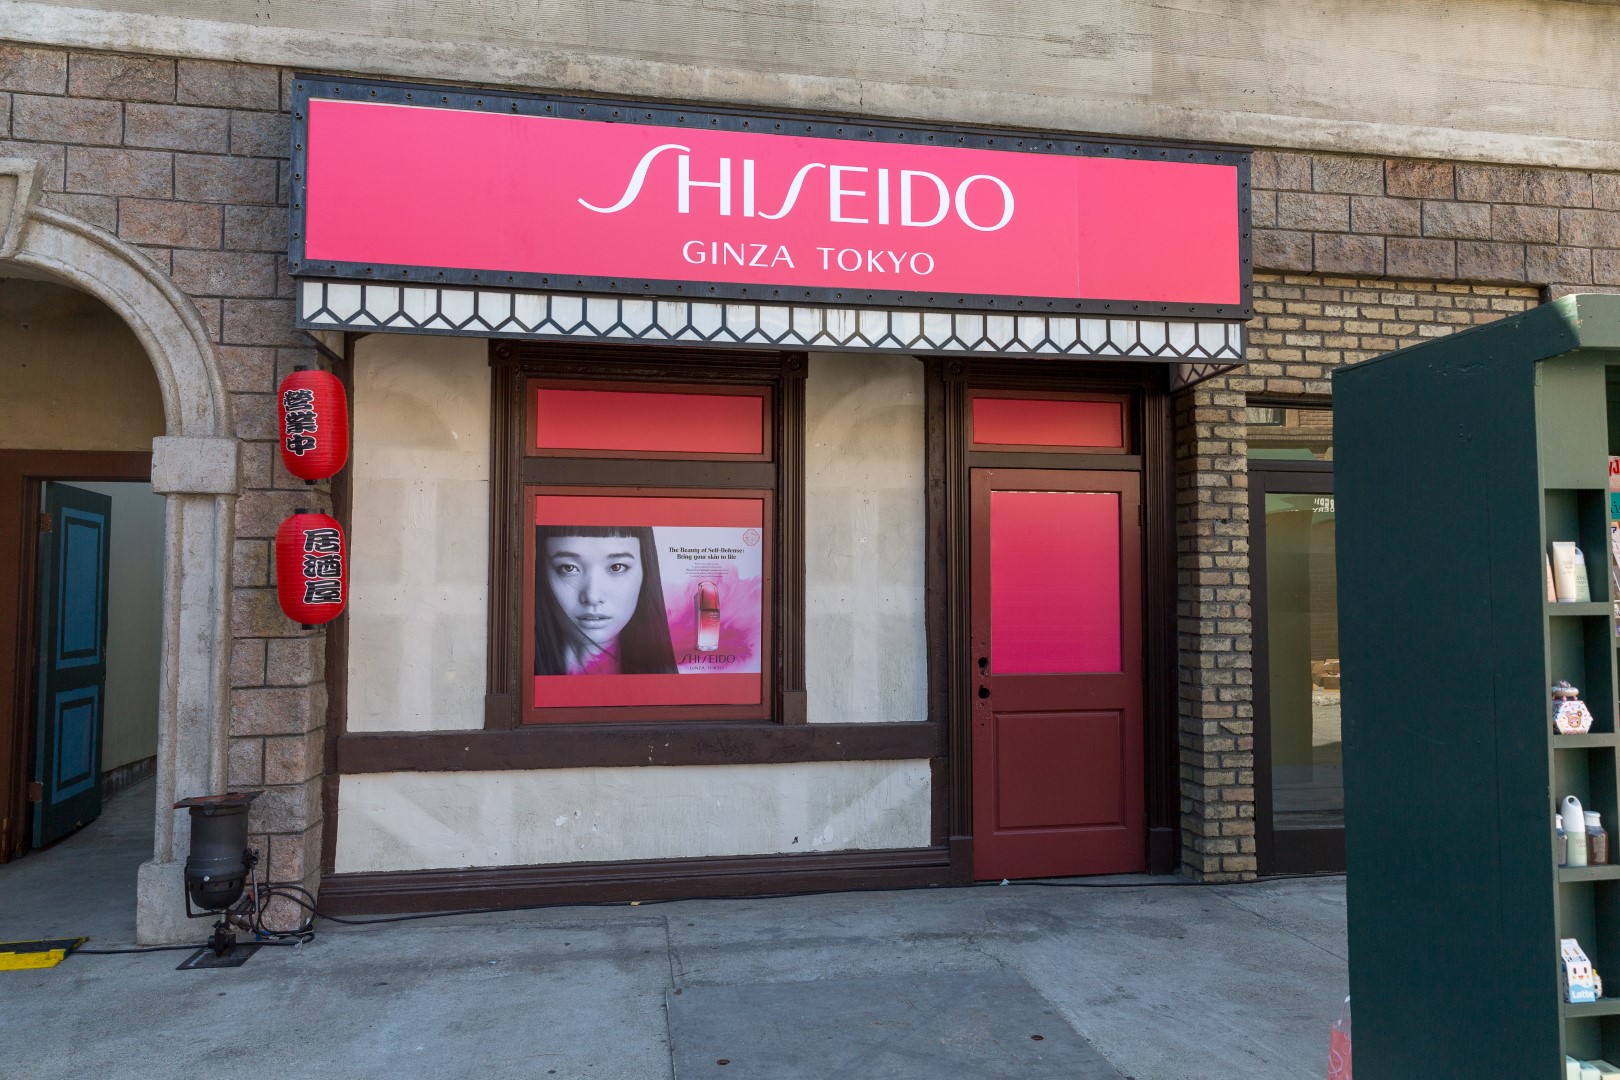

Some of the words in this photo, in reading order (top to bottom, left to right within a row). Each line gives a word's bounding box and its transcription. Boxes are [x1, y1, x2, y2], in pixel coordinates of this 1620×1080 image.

[577, 143, 1015, 232] SHISEIDO
[682, 240, 795, 269] GINZA
[816, 247, 935, 275] TOKYO
[680, 547, 700, 555] Beauty
[303, 528, 342, 604] 居酒屋
[677, 653, 736, 665] SHISEIDO
[1571, 990, 1595, 999] Latte
